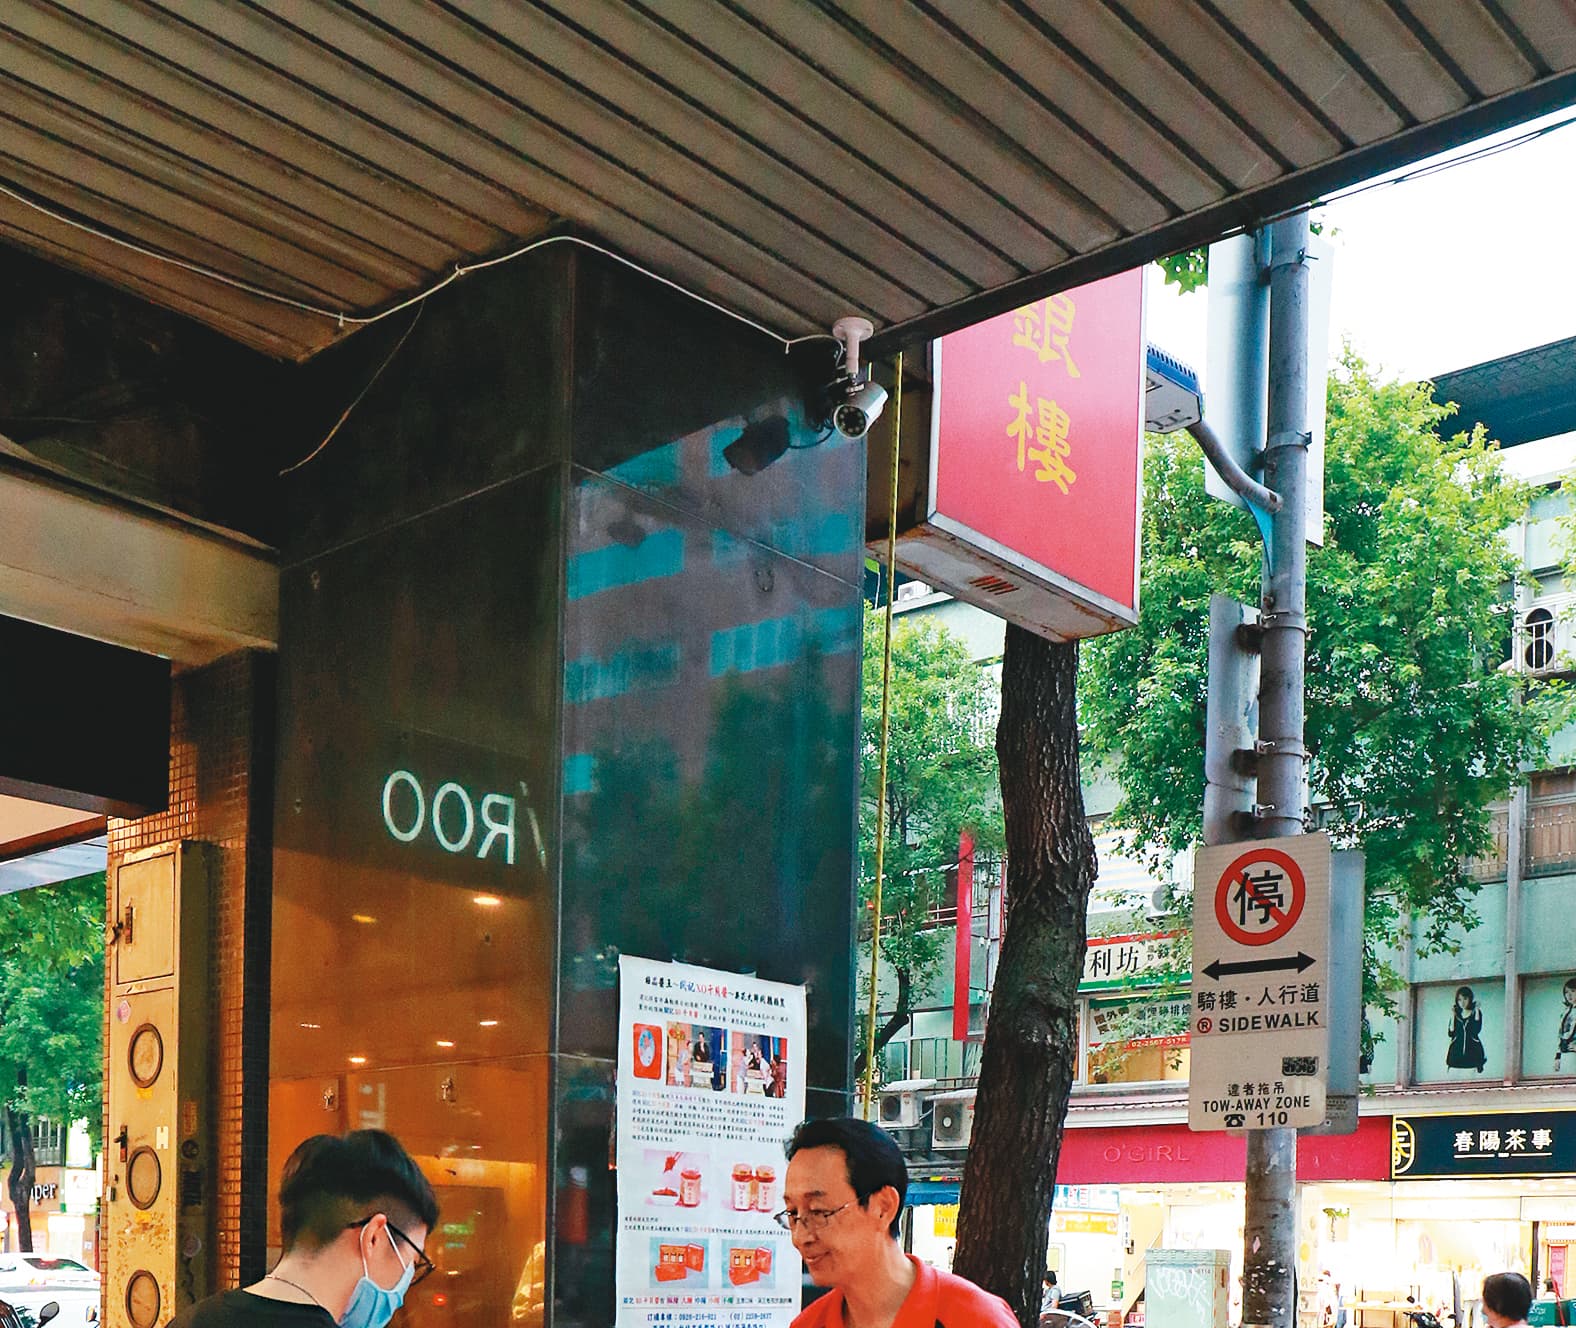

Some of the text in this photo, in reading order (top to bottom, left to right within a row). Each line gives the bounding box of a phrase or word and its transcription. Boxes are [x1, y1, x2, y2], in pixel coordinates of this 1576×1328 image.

[1006, 295, 1080, 495] 銀樓
[1232, 870, 1285, 927] 停
[1218, 1011, 1320, 1033] SIDEWALK
[1203, 1095, 1311, 1113] TOW-AWAY ZONE
[1256, 1111, 1288, 1126] 110
[1453, 1127, 1553, 1152] 春陽茶事
